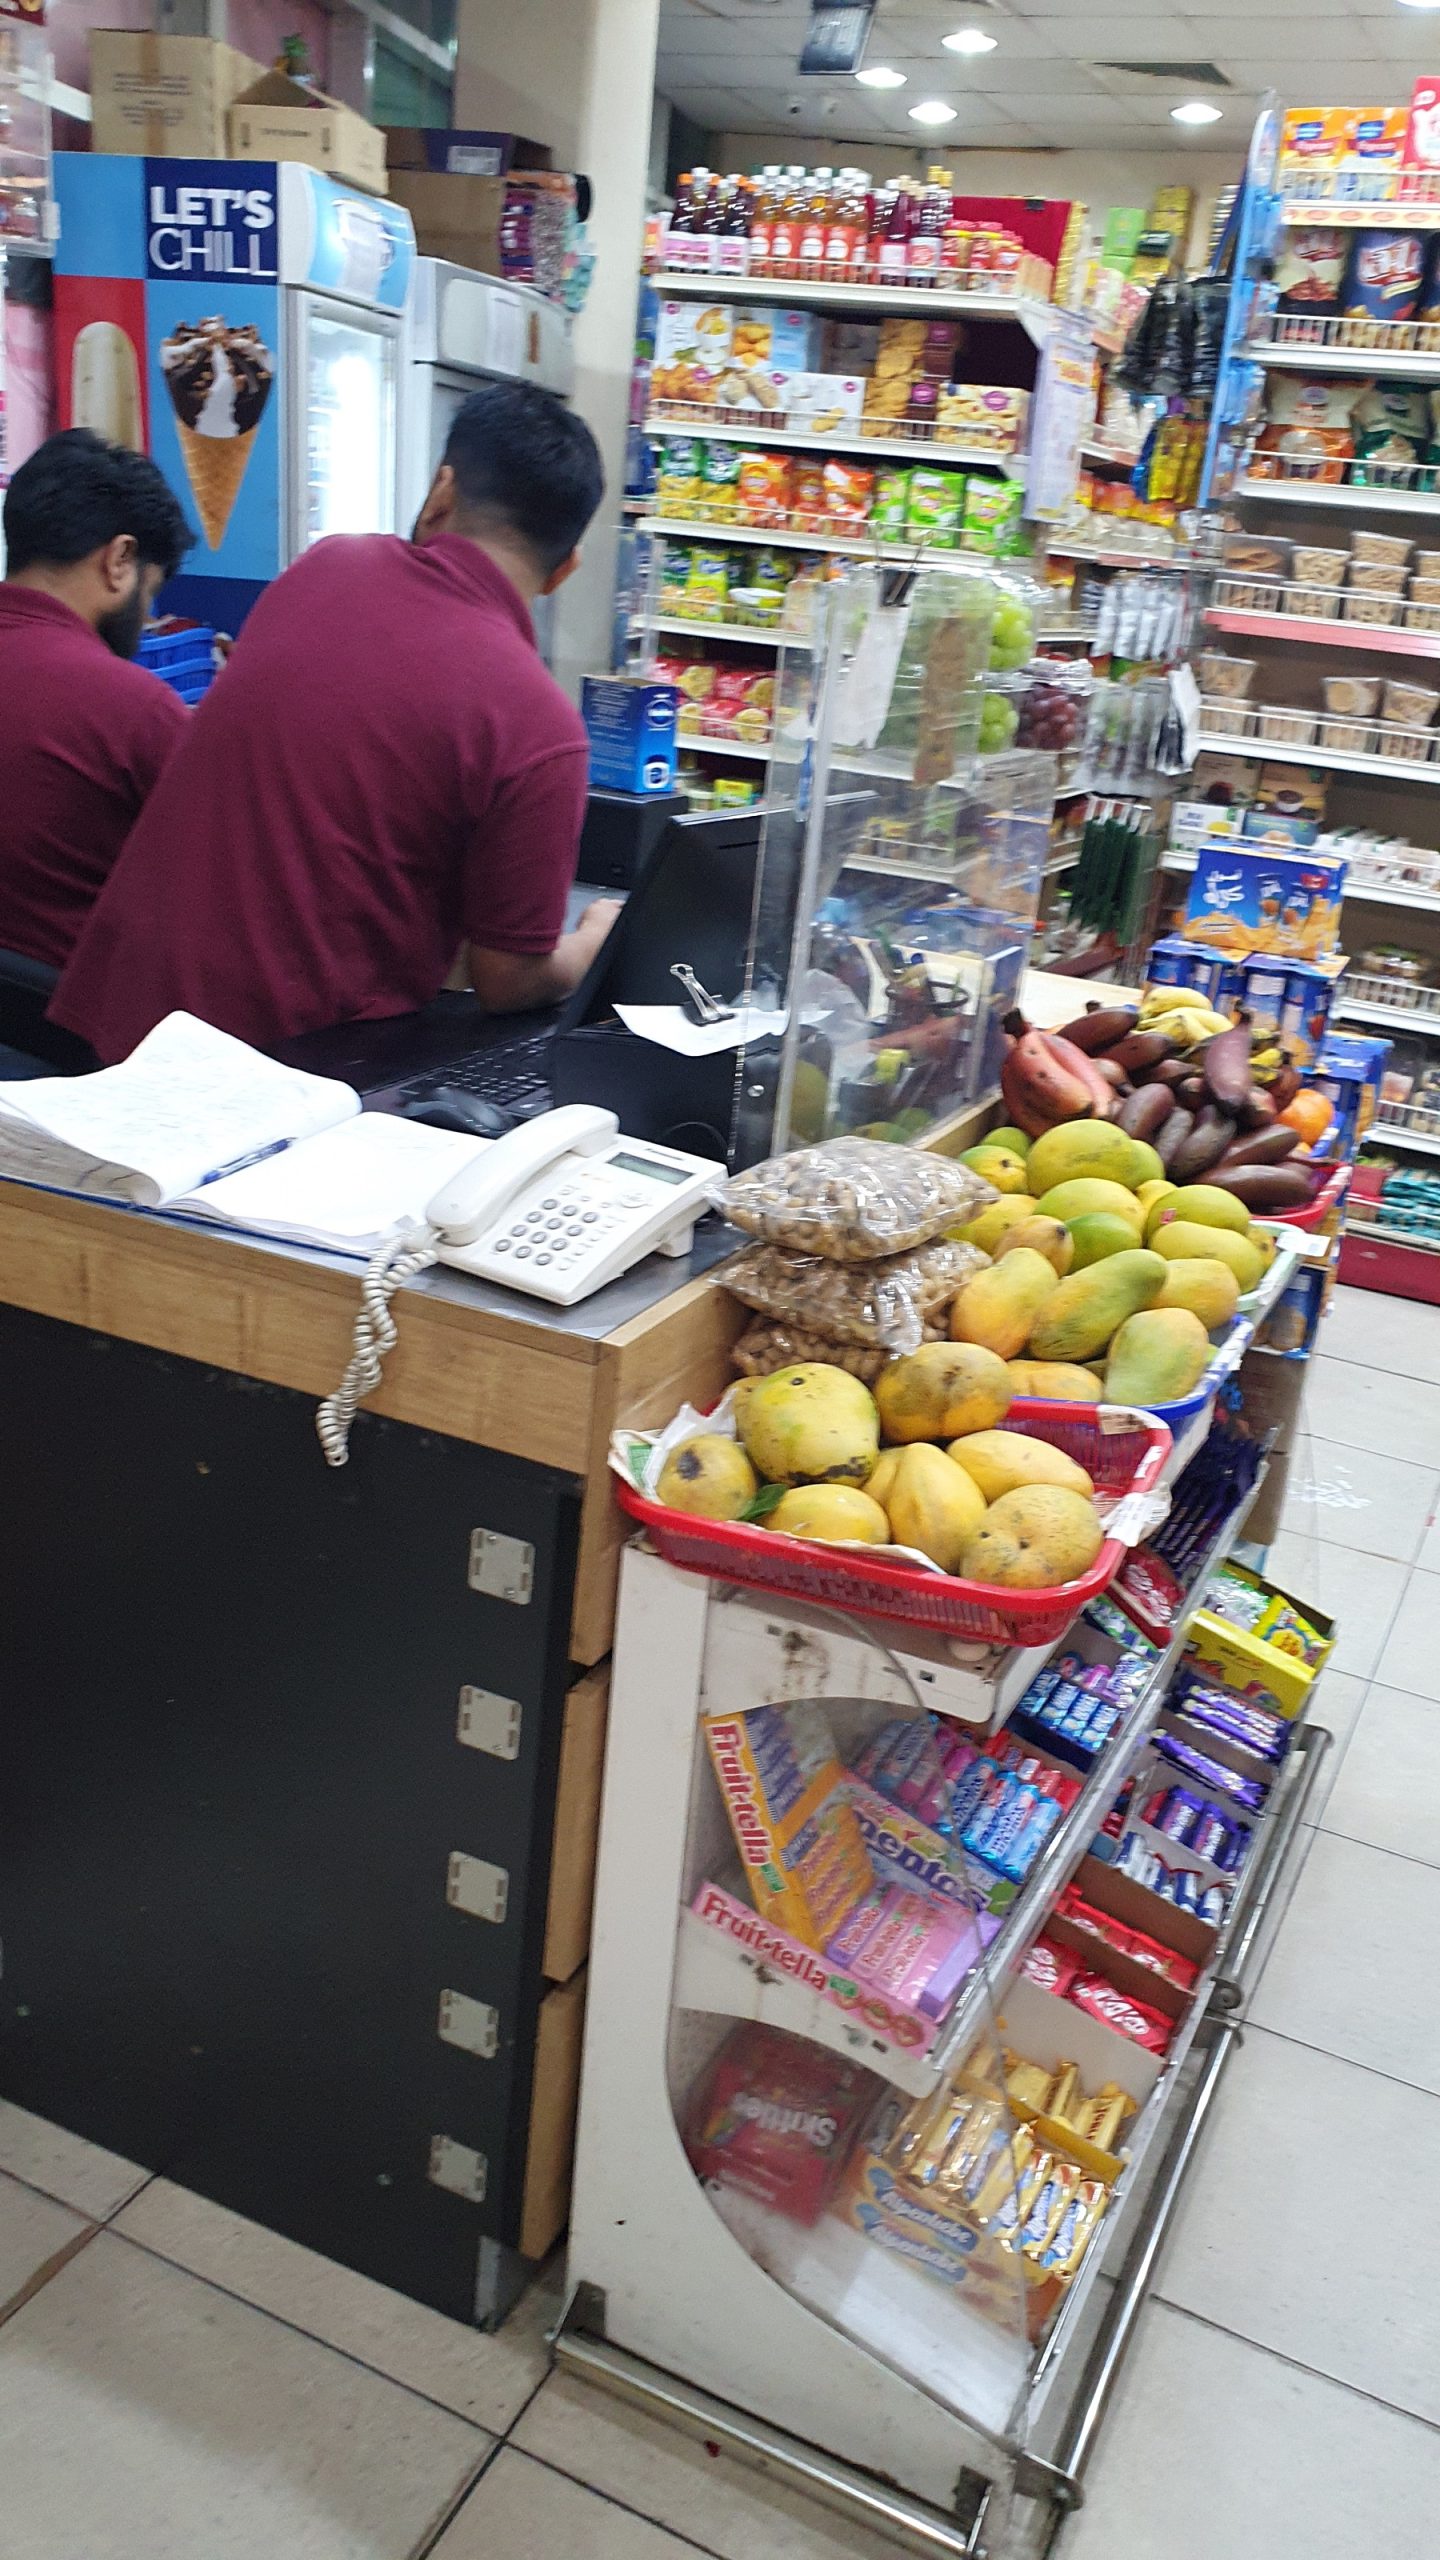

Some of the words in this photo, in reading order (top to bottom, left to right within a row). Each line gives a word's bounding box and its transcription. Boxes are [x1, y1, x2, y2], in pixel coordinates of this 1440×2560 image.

[150, 186, 275, 229] LET'S
[149, 227, 278, 277] CHILL
[709, 1722, 771, 1866] Fruit-tella
[701, 1890, 828, 1991] Fruit-tella
